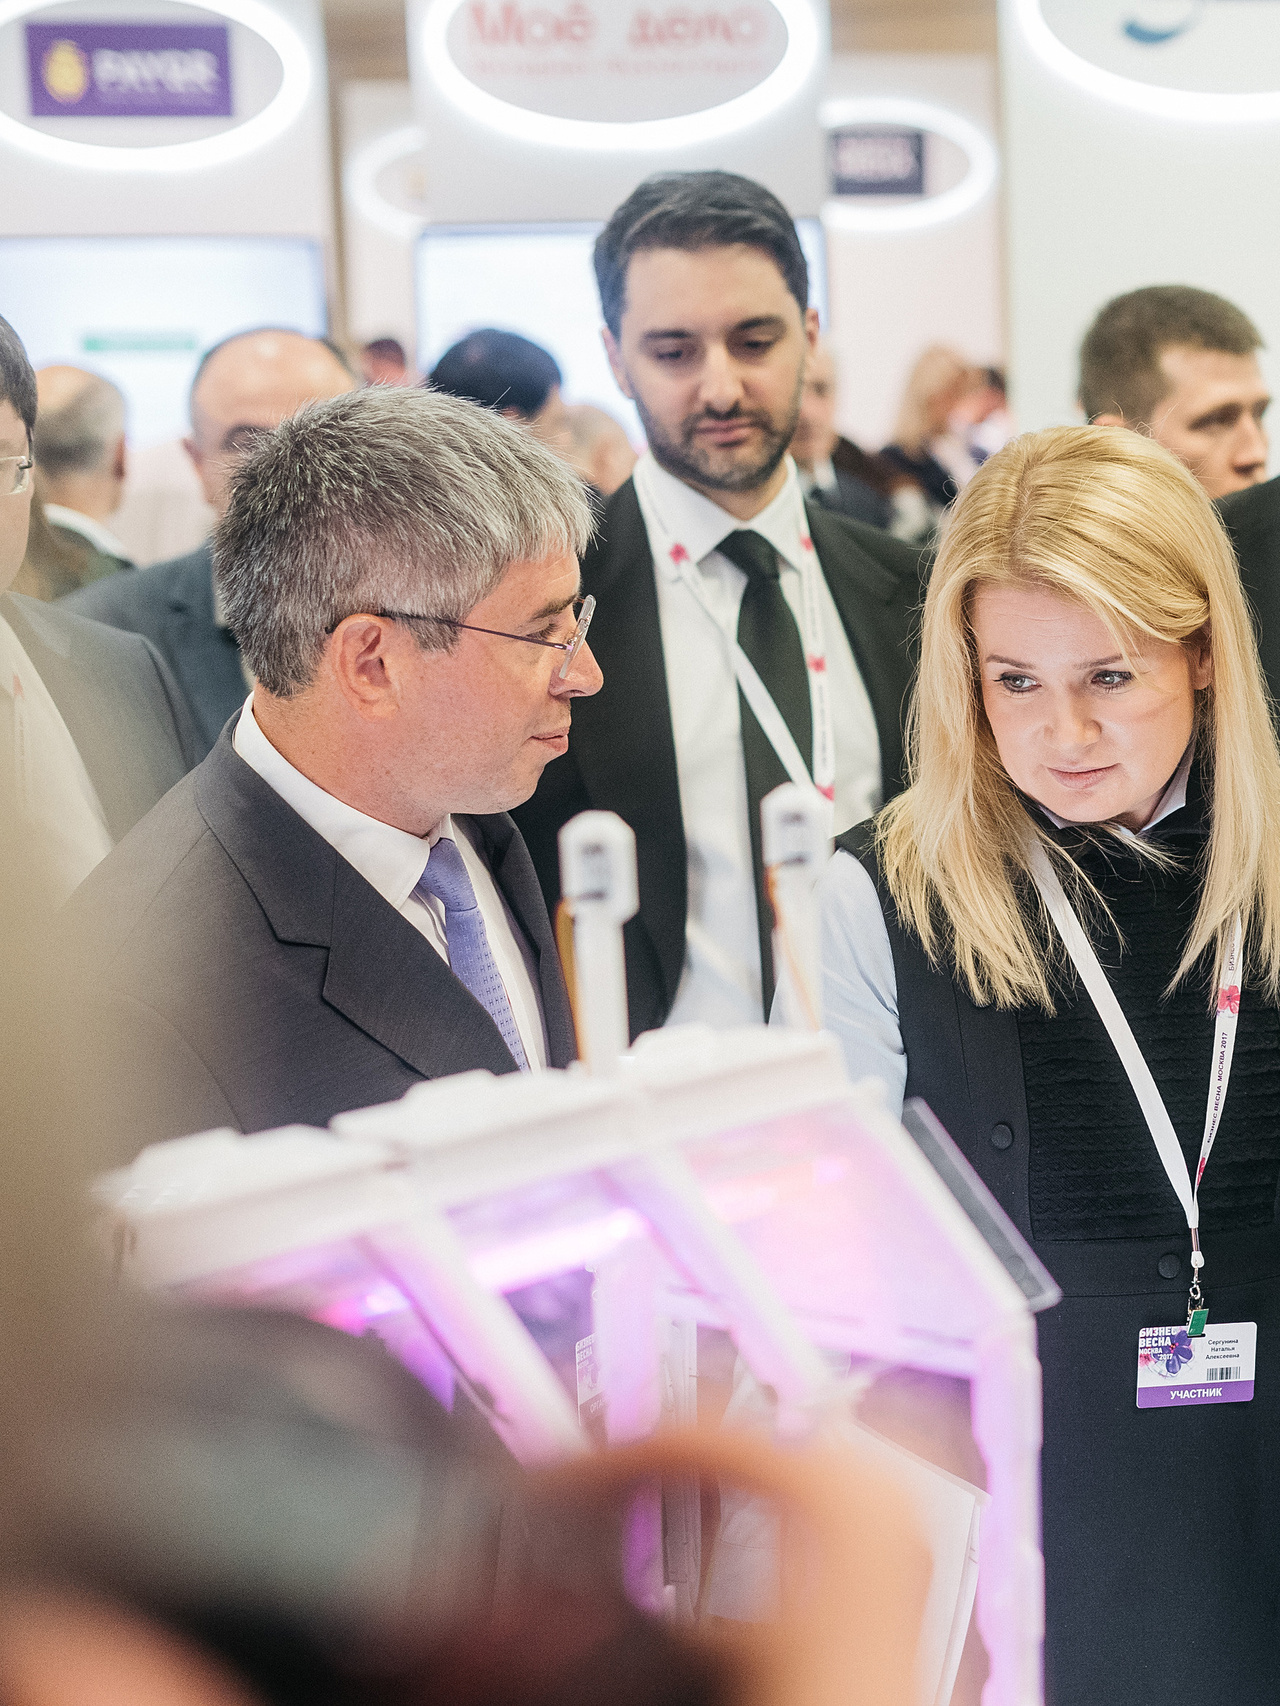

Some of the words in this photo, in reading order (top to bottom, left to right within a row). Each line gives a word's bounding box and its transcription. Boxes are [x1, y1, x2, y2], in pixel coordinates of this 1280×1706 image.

[1217, 1050, 1226, 1081] МОСКВА
[1214, 1085, 1222, 1111] ВЕСНА
[1139, 1327, 1177, 1337] БИЗНЕС
[1139, 1336, 1172, 1347] ВЕСНА
[1139, 1347, 1163, 1355] МОСКВА
[1170, 1387, 1223, 1400] УЧАСТНИК
